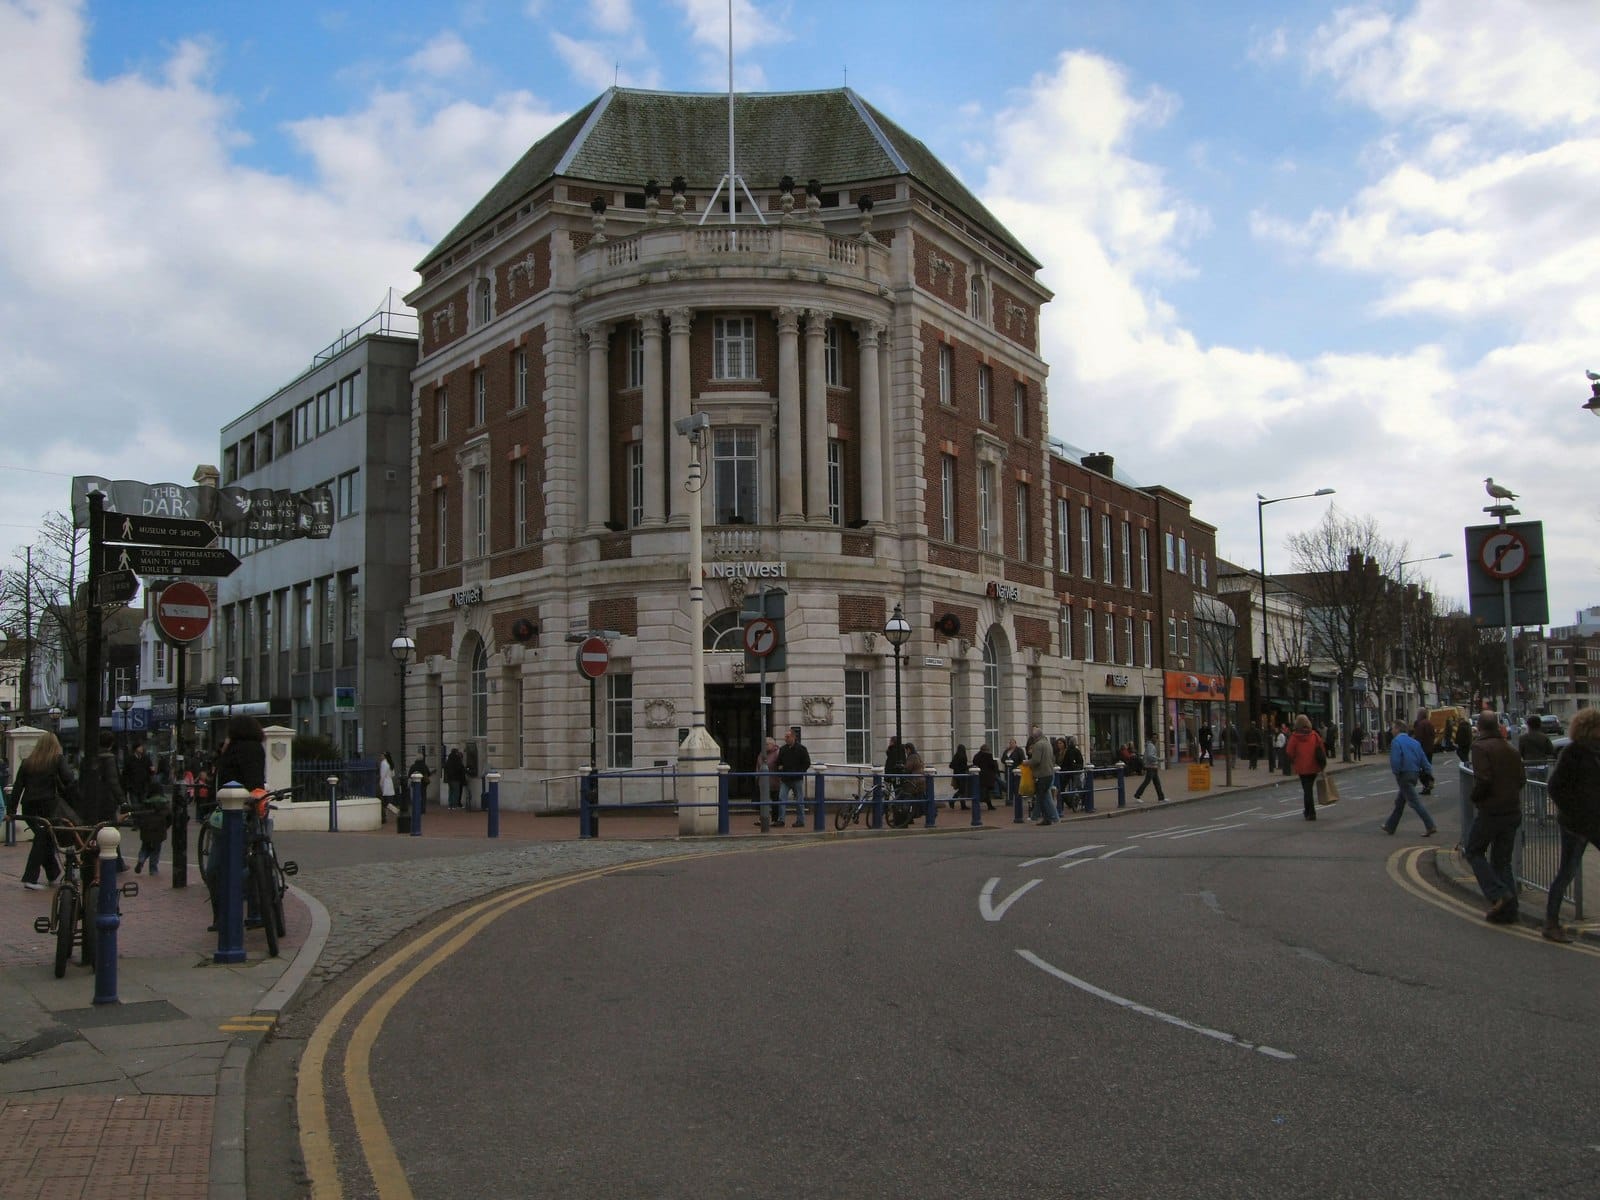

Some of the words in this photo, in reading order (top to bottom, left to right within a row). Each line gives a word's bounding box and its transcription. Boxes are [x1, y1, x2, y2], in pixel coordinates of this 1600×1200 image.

[143, 498, 192, 518] DARK
[139, 527, 166, 535] MUSEUM
[168, 528, 177, 536] OF
[180, 529, 201, 537] SHOPS
[141, 549, 171, 557] TOURIST
[174, 550, 225, 558] INFORMATION
[163, 558, 201, 566] THEATRES
[141, 565, 169, 573] TOILETS
[712, 562, 787, 577] NatWest
